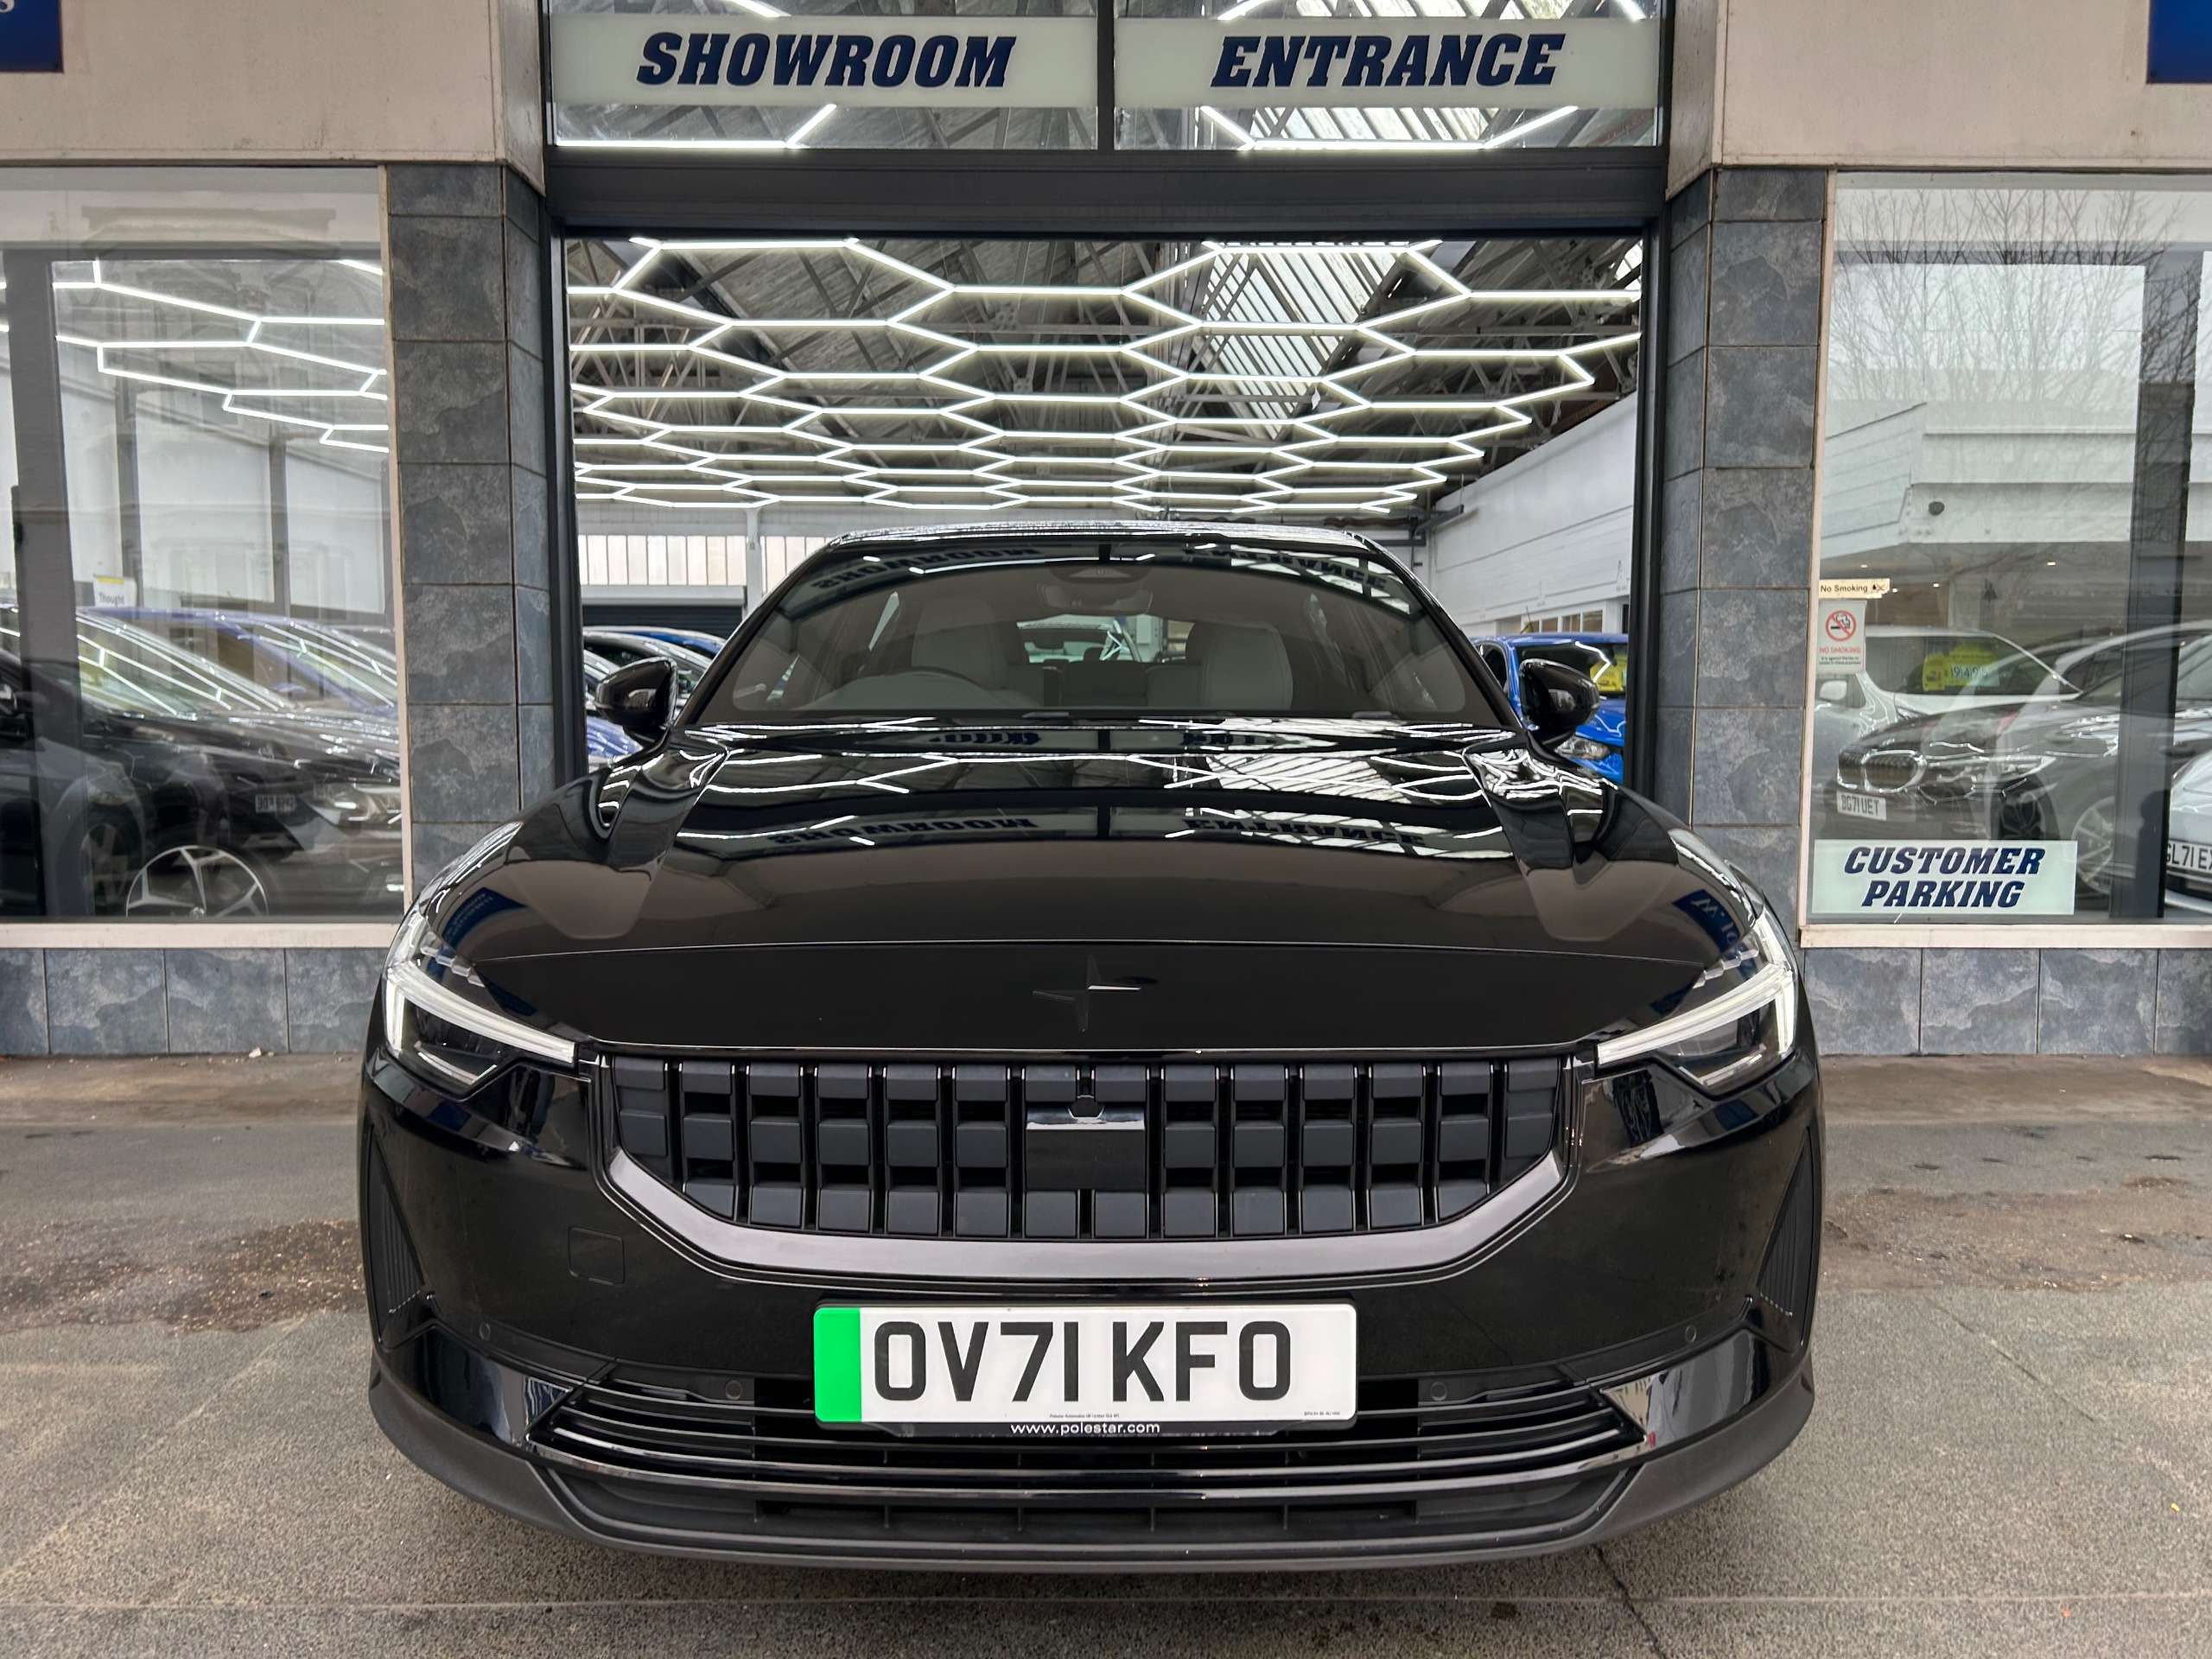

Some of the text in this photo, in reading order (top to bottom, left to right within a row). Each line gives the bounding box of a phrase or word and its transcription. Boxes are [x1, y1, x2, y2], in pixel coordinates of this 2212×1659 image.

[637, 32, 1566, 87] SHOWROOM ENTRANCE
[1834, 584, 1868, 593] Smoking
[1845, 847, 2045, 875] CUSTOMER
[1862, 880, 2025, 908] PARKING
[874, 1320, 1291, 1402] OV71 KFO
[1011, 1421, 1160, 1436] www.polestar.com
